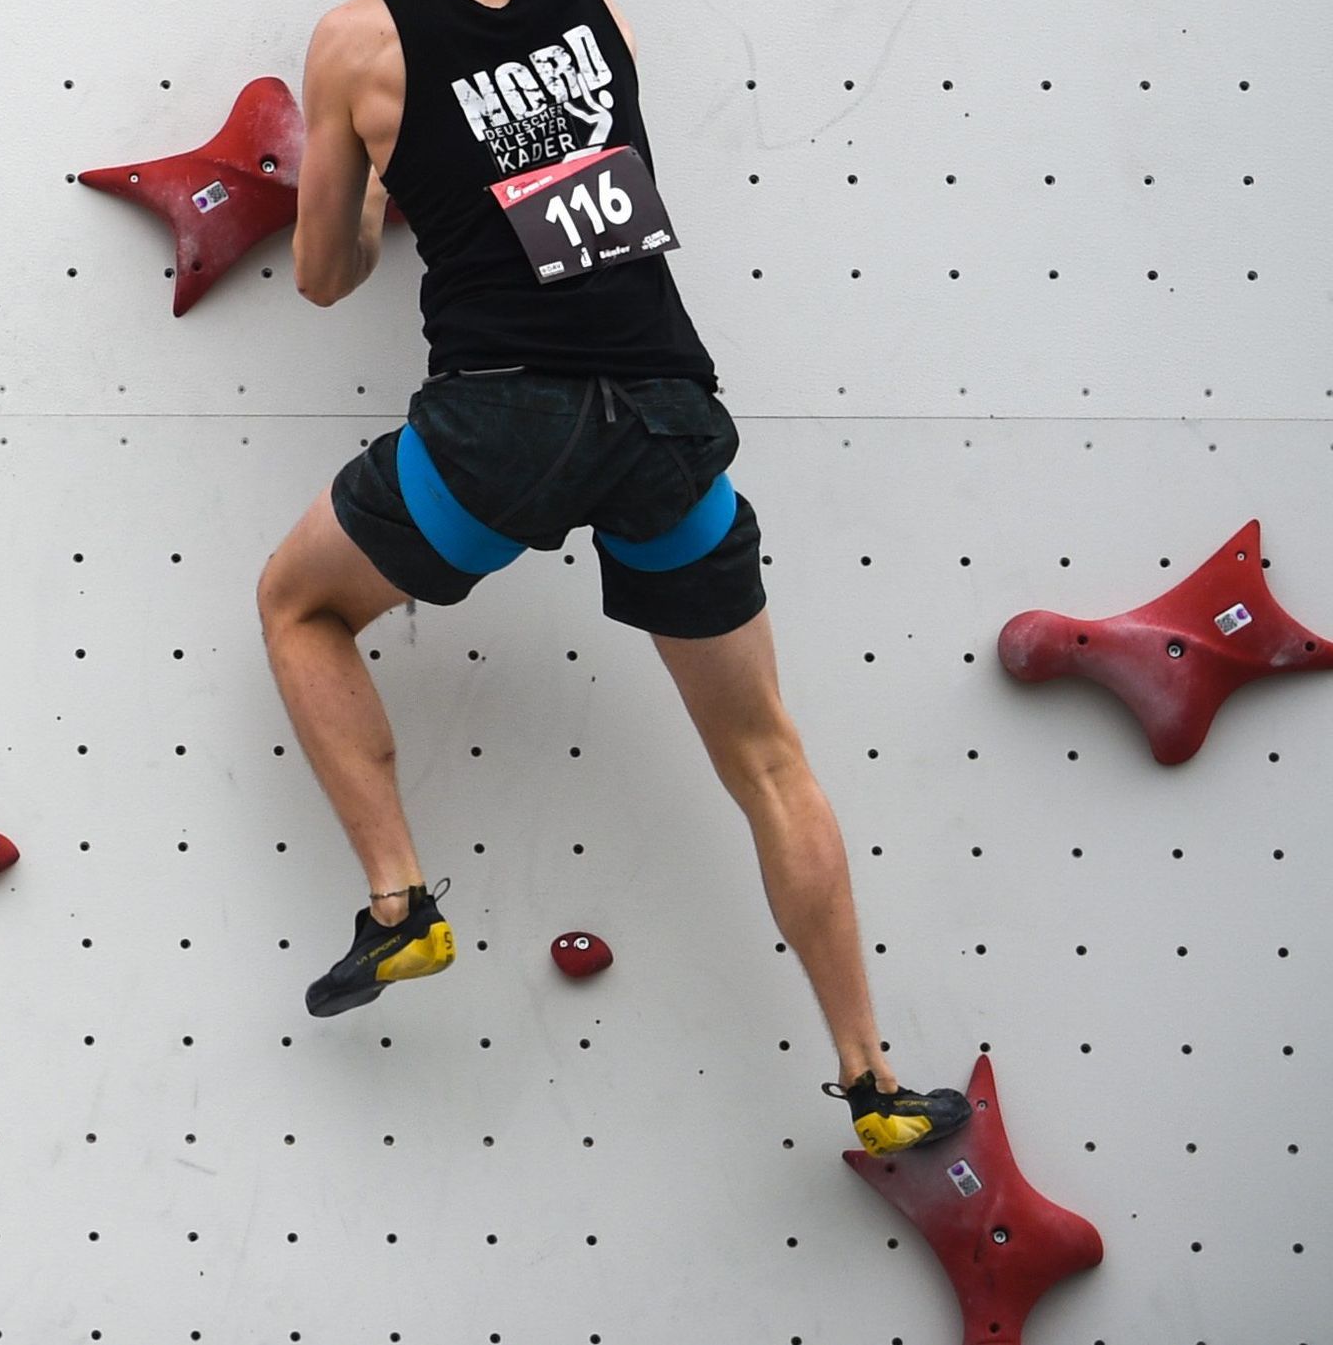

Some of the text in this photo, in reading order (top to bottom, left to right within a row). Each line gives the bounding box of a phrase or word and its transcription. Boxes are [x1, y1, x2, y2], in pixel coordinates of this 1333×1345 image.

[451, 24, 613, 142] NORD
[484, 105, 563, 140] DEUTSCHER
[489, 116, 568, 154] KLETTER
[496, 133, 576, 174] KADER
[545, 170, 633, 247] 116
